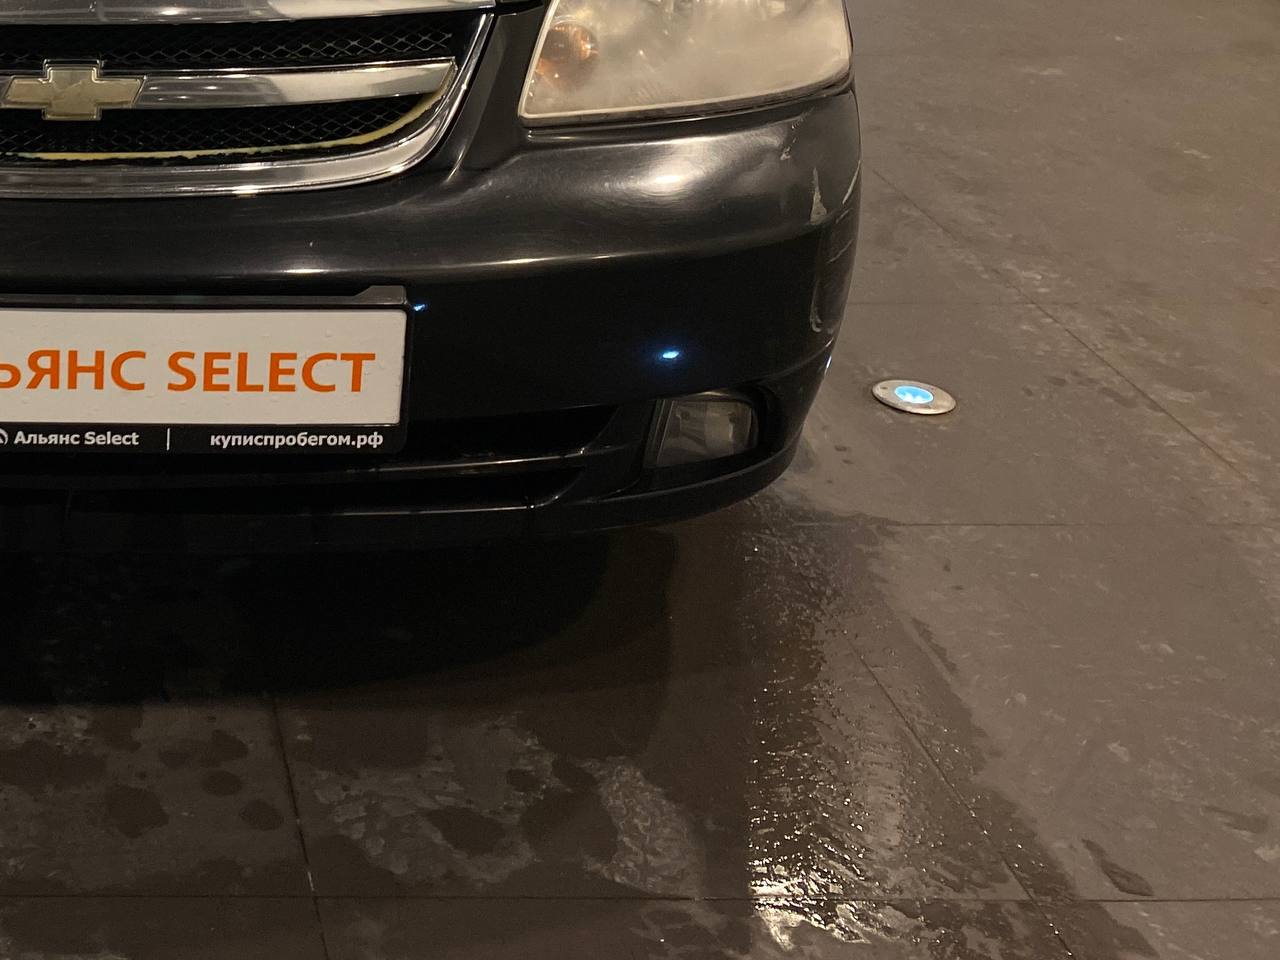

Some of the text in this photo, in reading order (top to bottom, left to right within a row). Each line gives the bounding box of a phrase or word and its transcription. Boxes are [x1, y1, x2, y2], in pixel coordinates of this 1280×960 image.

[167, 350, 376, 393] SELECT
[13, 430, 140, 446] Альянс Select
[210, 431, 384, 449] куписпробегом.рф
